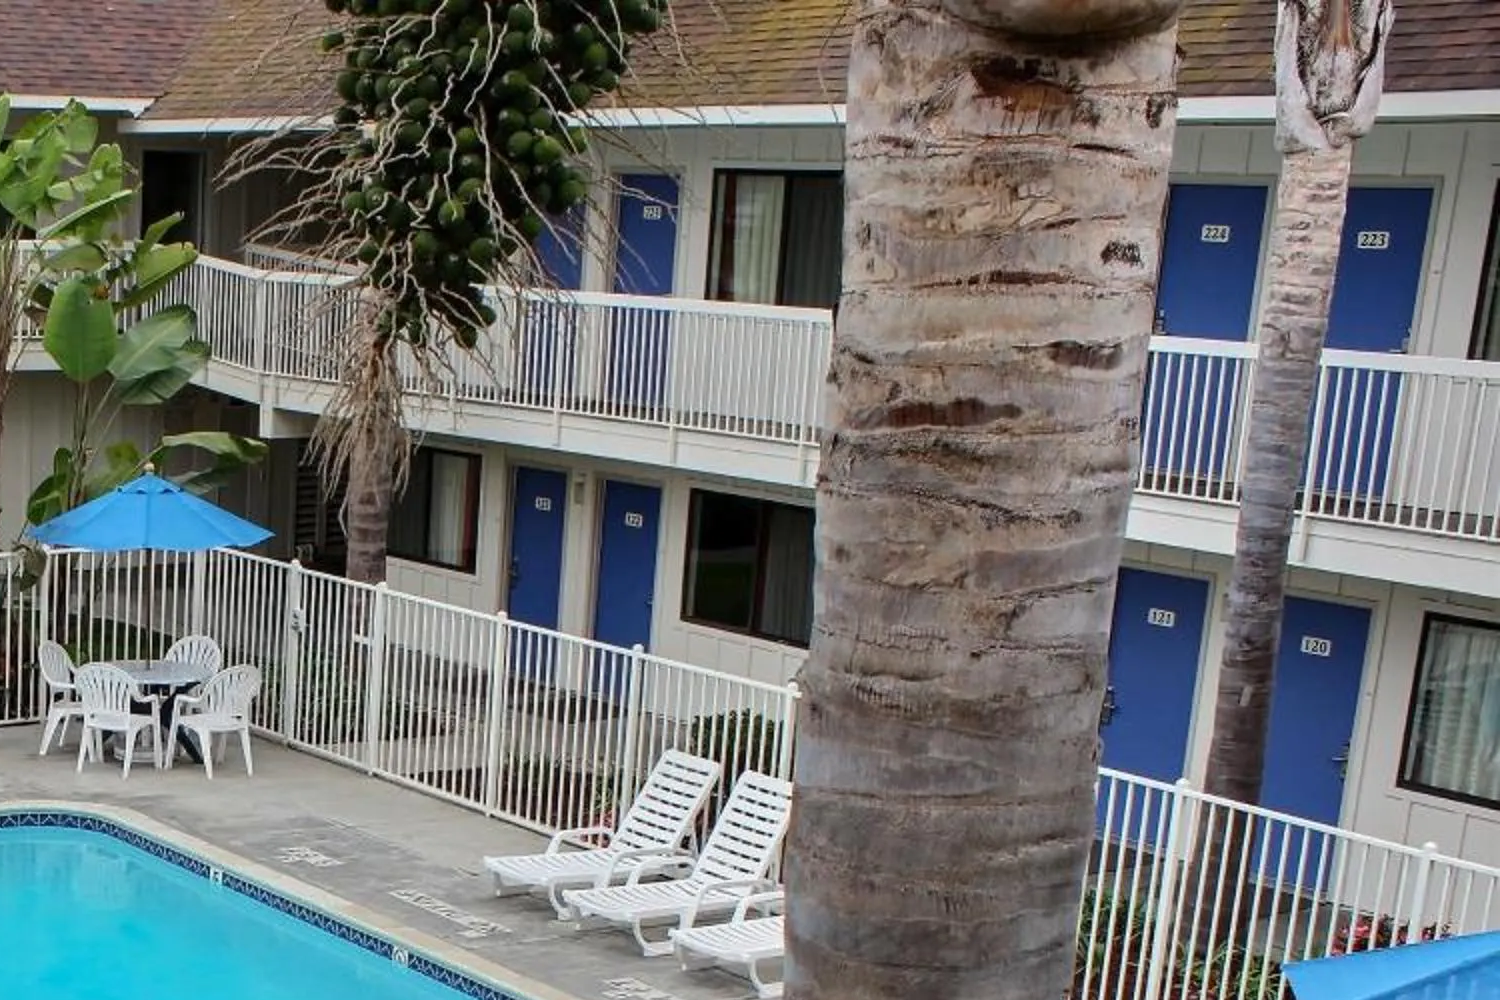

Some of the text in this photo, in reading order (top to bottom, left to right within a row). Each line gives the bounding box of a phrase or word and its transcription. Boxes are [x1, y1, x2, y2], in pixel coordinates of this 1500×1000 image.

[1360, 232, 1387, 247] 223
[1152, 610, 1173, 625] 121
[1304, 639, 1328, 654] 120
